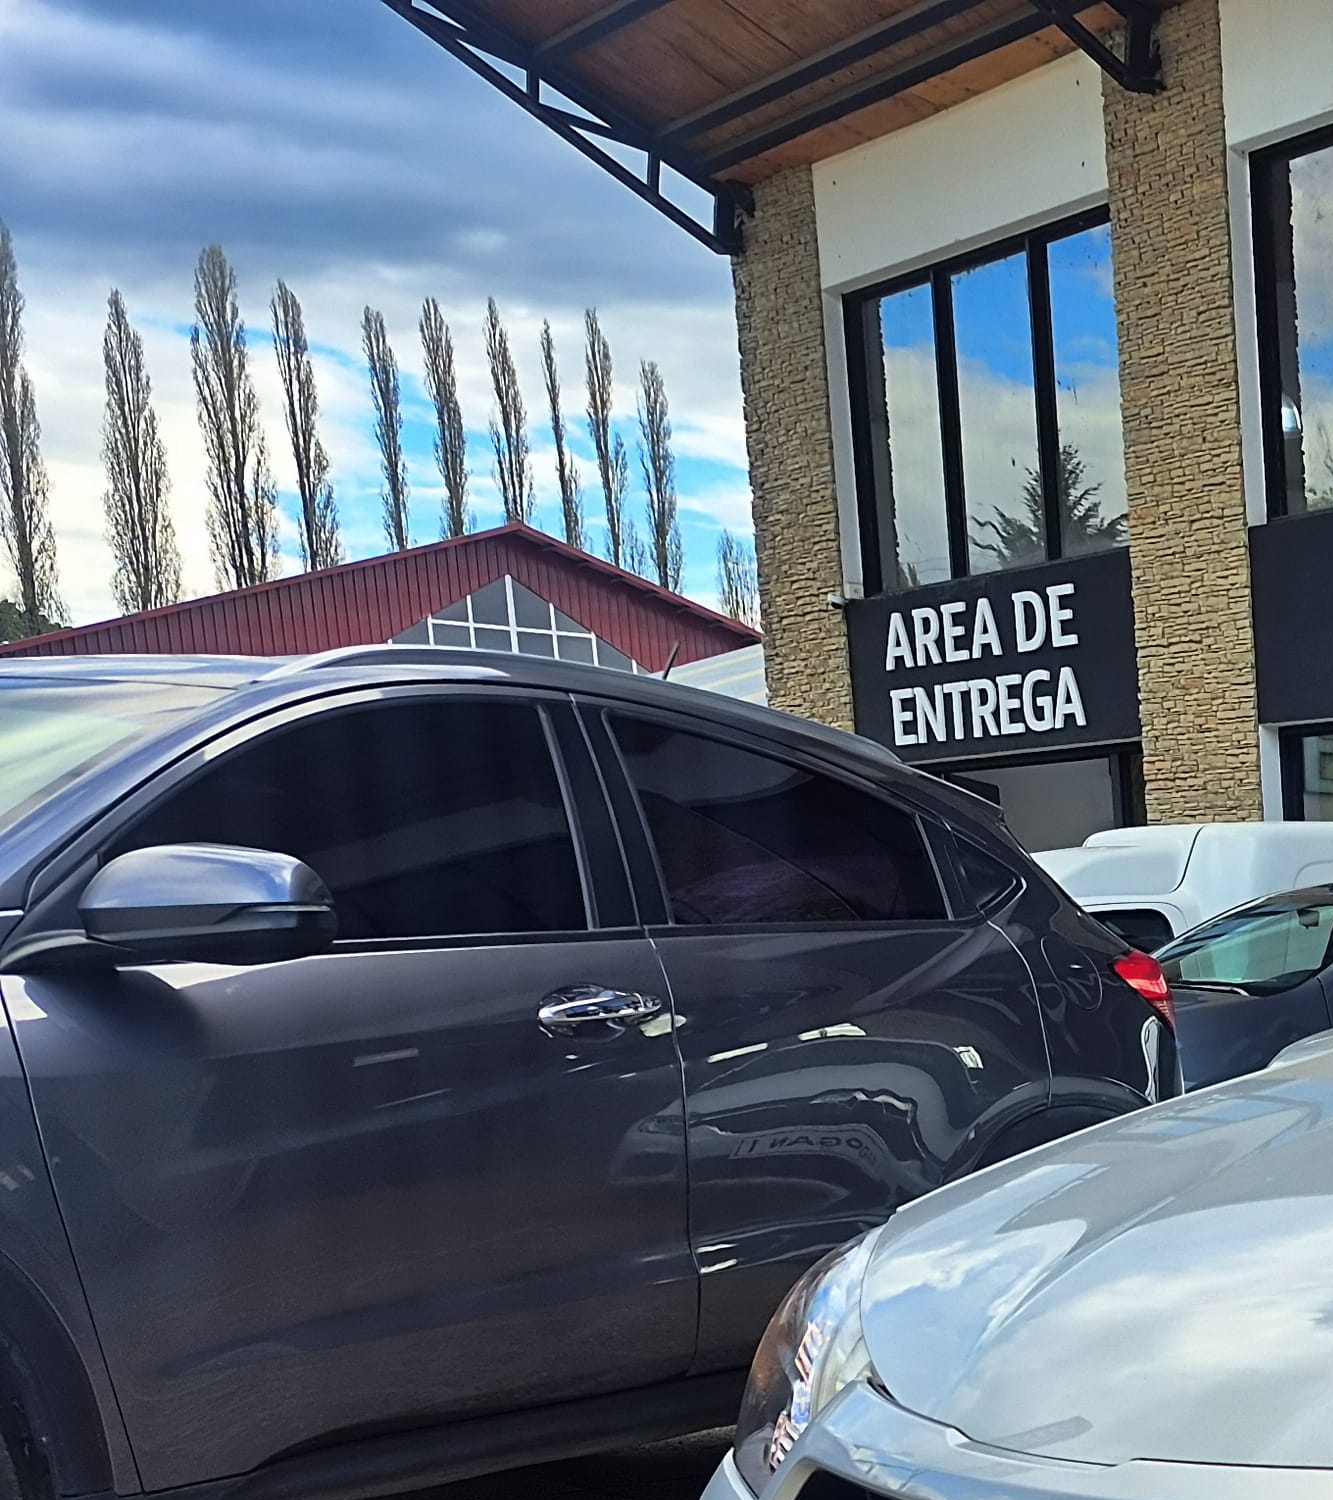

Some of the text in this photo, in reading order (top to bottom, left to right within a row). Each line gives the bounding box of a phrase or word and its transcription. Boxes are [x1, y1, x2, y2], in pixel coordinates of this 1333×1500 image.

[885, 583, 1079, 671] AREA DE
[889, 667, 1087, 746] ENTREGA
